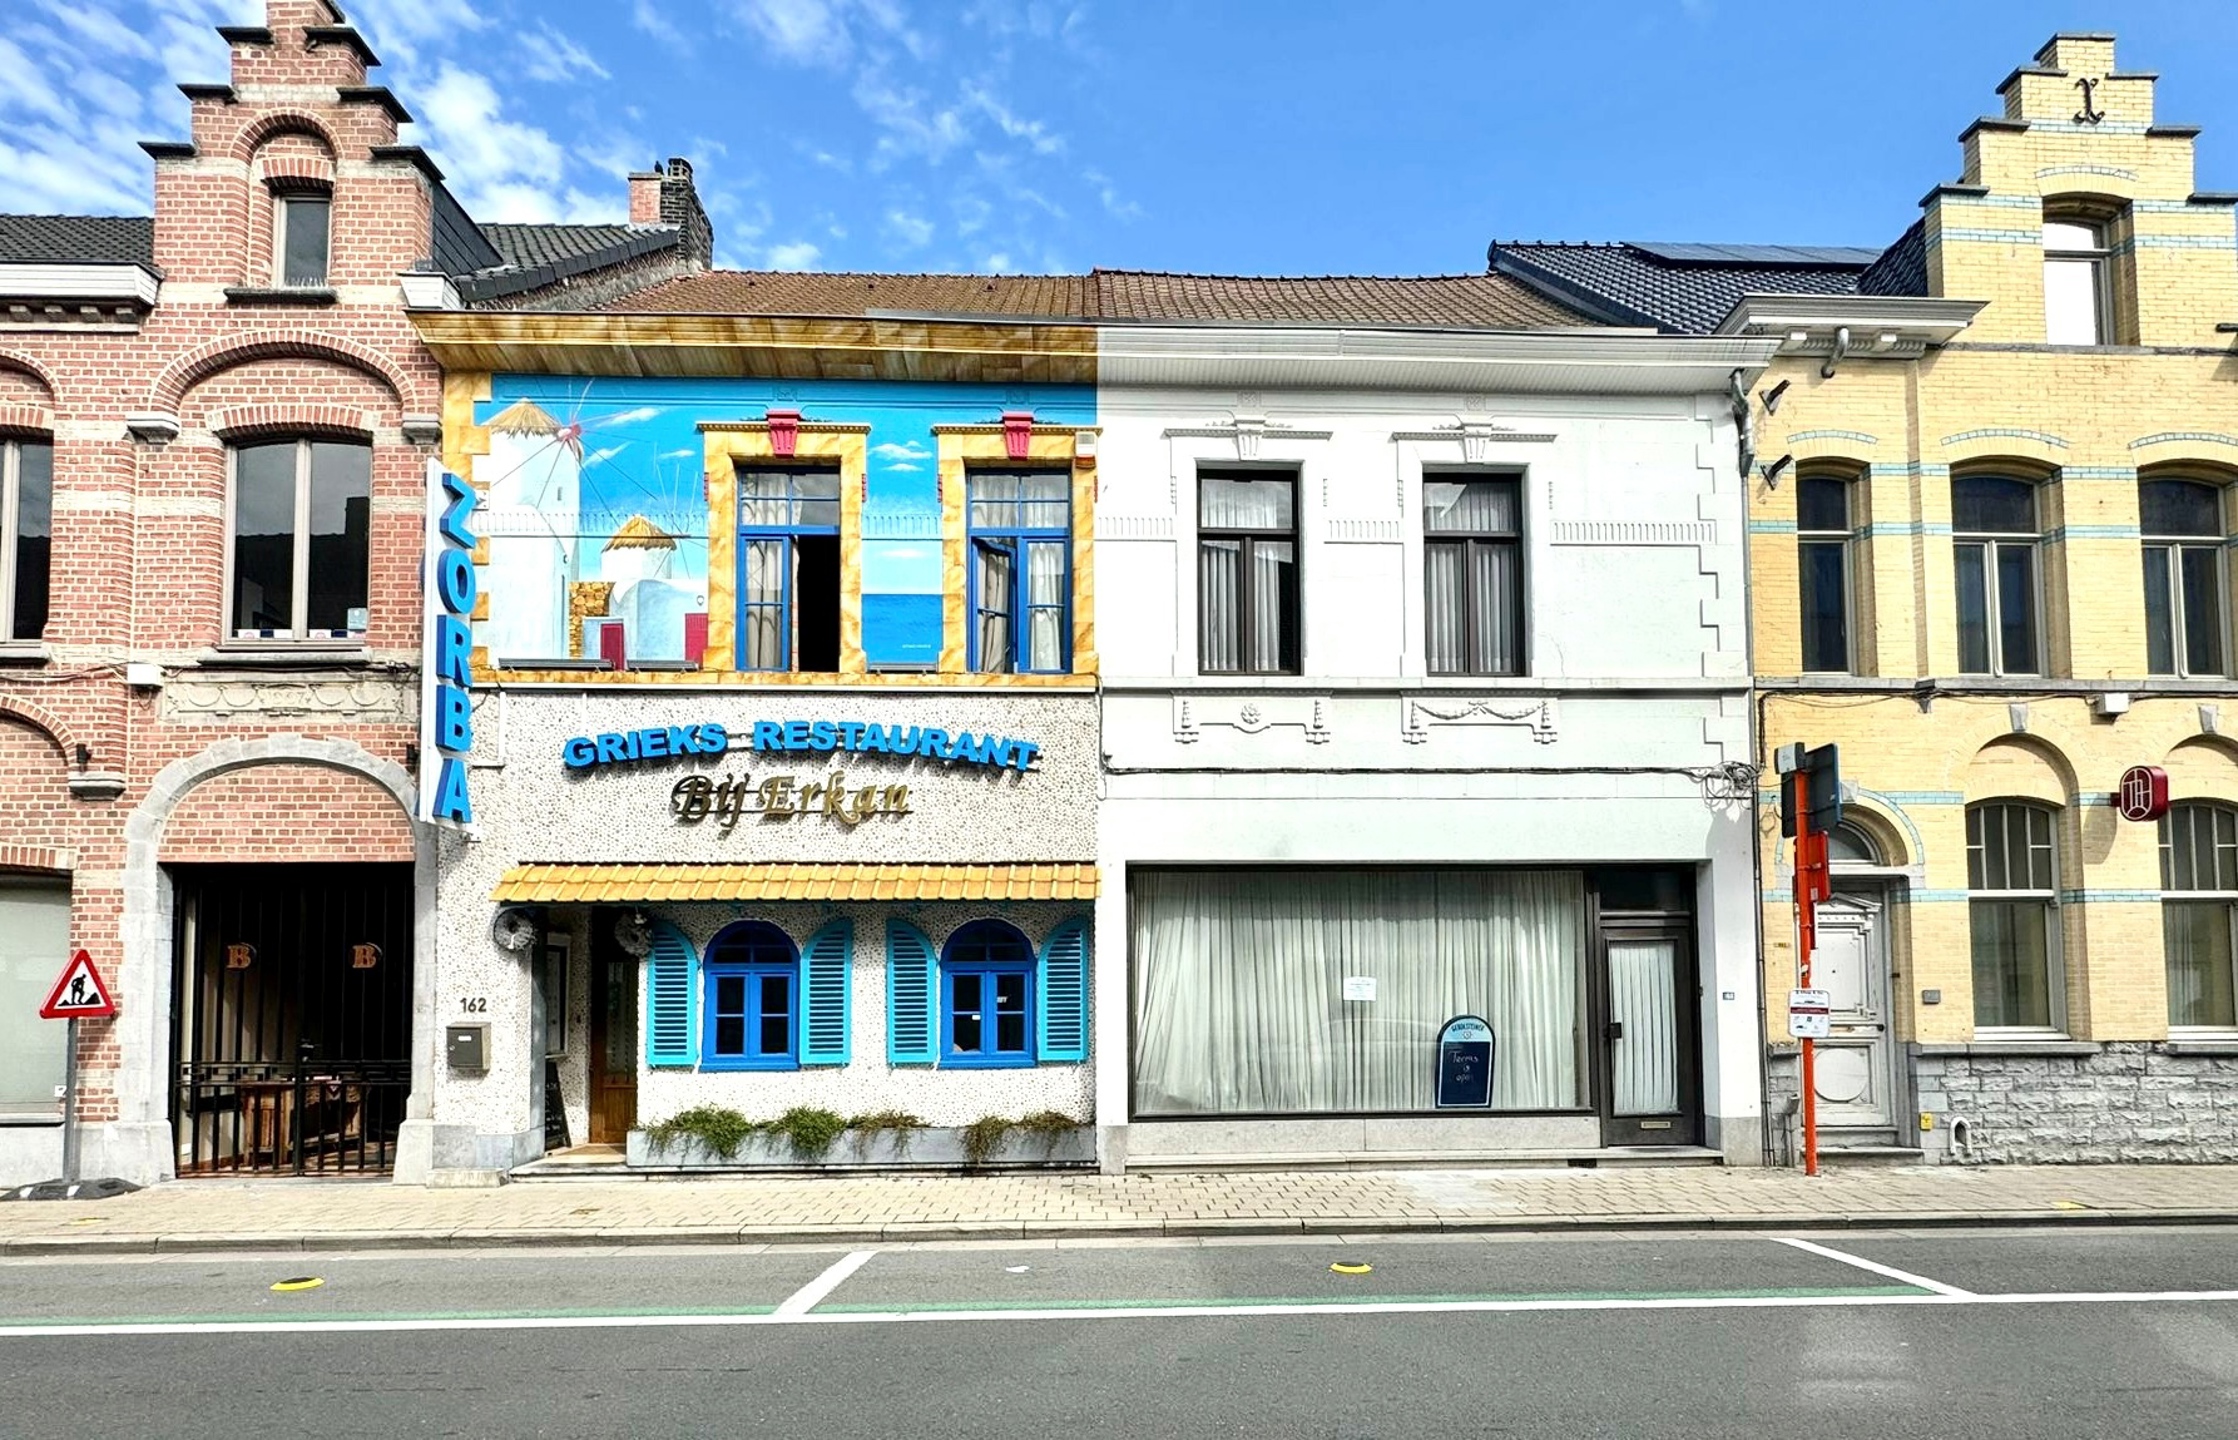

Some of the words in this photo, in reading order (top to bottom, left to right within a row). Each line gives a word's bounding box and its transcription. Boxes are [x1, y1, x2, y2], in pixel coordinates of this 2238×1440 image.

[433, 472, 477, 824] ZORBA
[563, 722, 729, 768] GRIEKS
[753, 719, 1040, 773] RESTAURANT
[671, 773, 750, 827] Bij
[757, 769, 911, 824] Erkan
[460, 997, 487, 1013] 162
